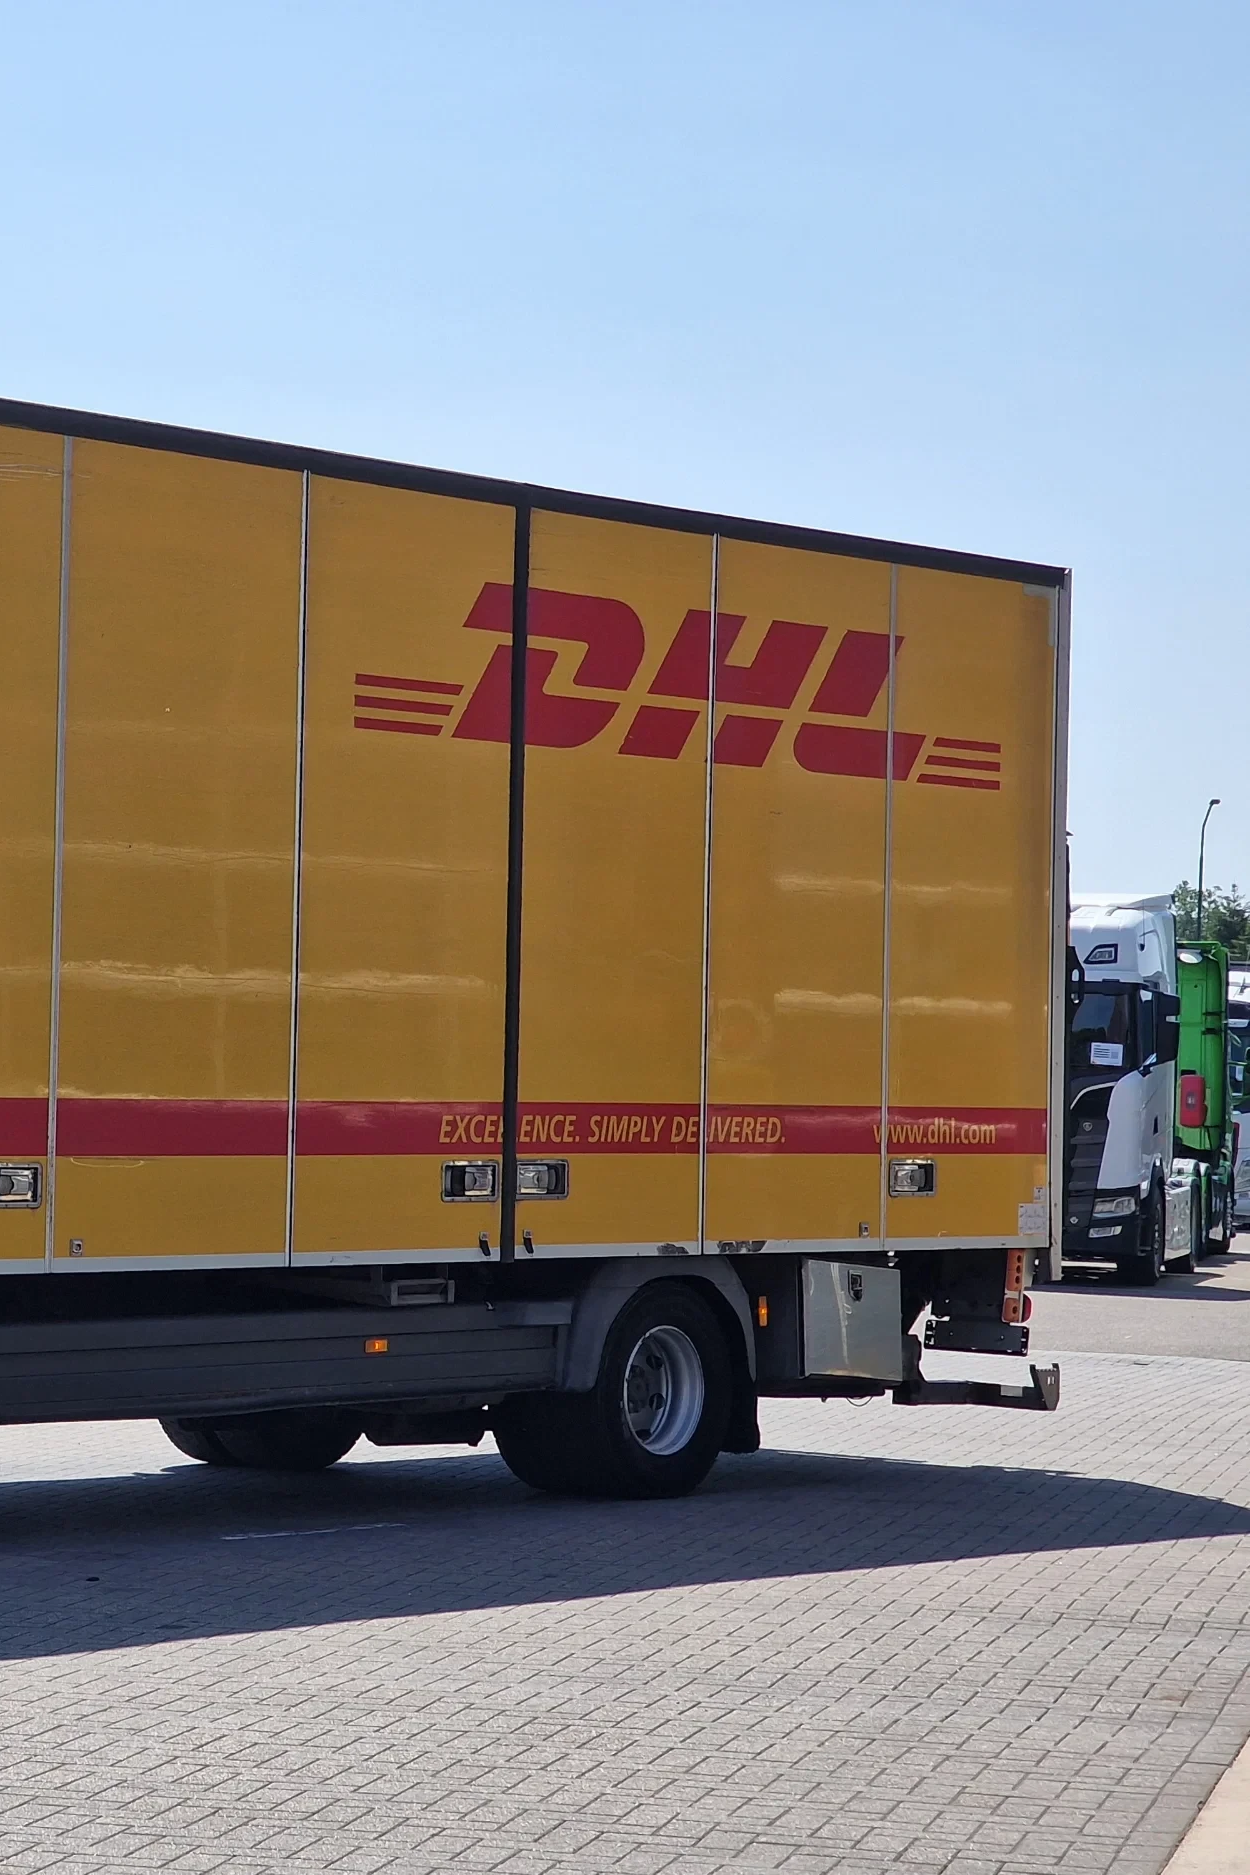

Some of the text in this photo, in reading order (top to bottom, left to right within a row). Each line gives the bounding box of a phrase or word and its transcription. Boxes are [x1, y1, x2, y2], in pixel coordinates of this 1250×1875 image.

[450, 582, 927, 781] DHL
[439, 1114, 786, 1144] EXCELENCE. SIMPLY DEIVERED.
[872, 1116, 997, 1145] www.dhl.com
